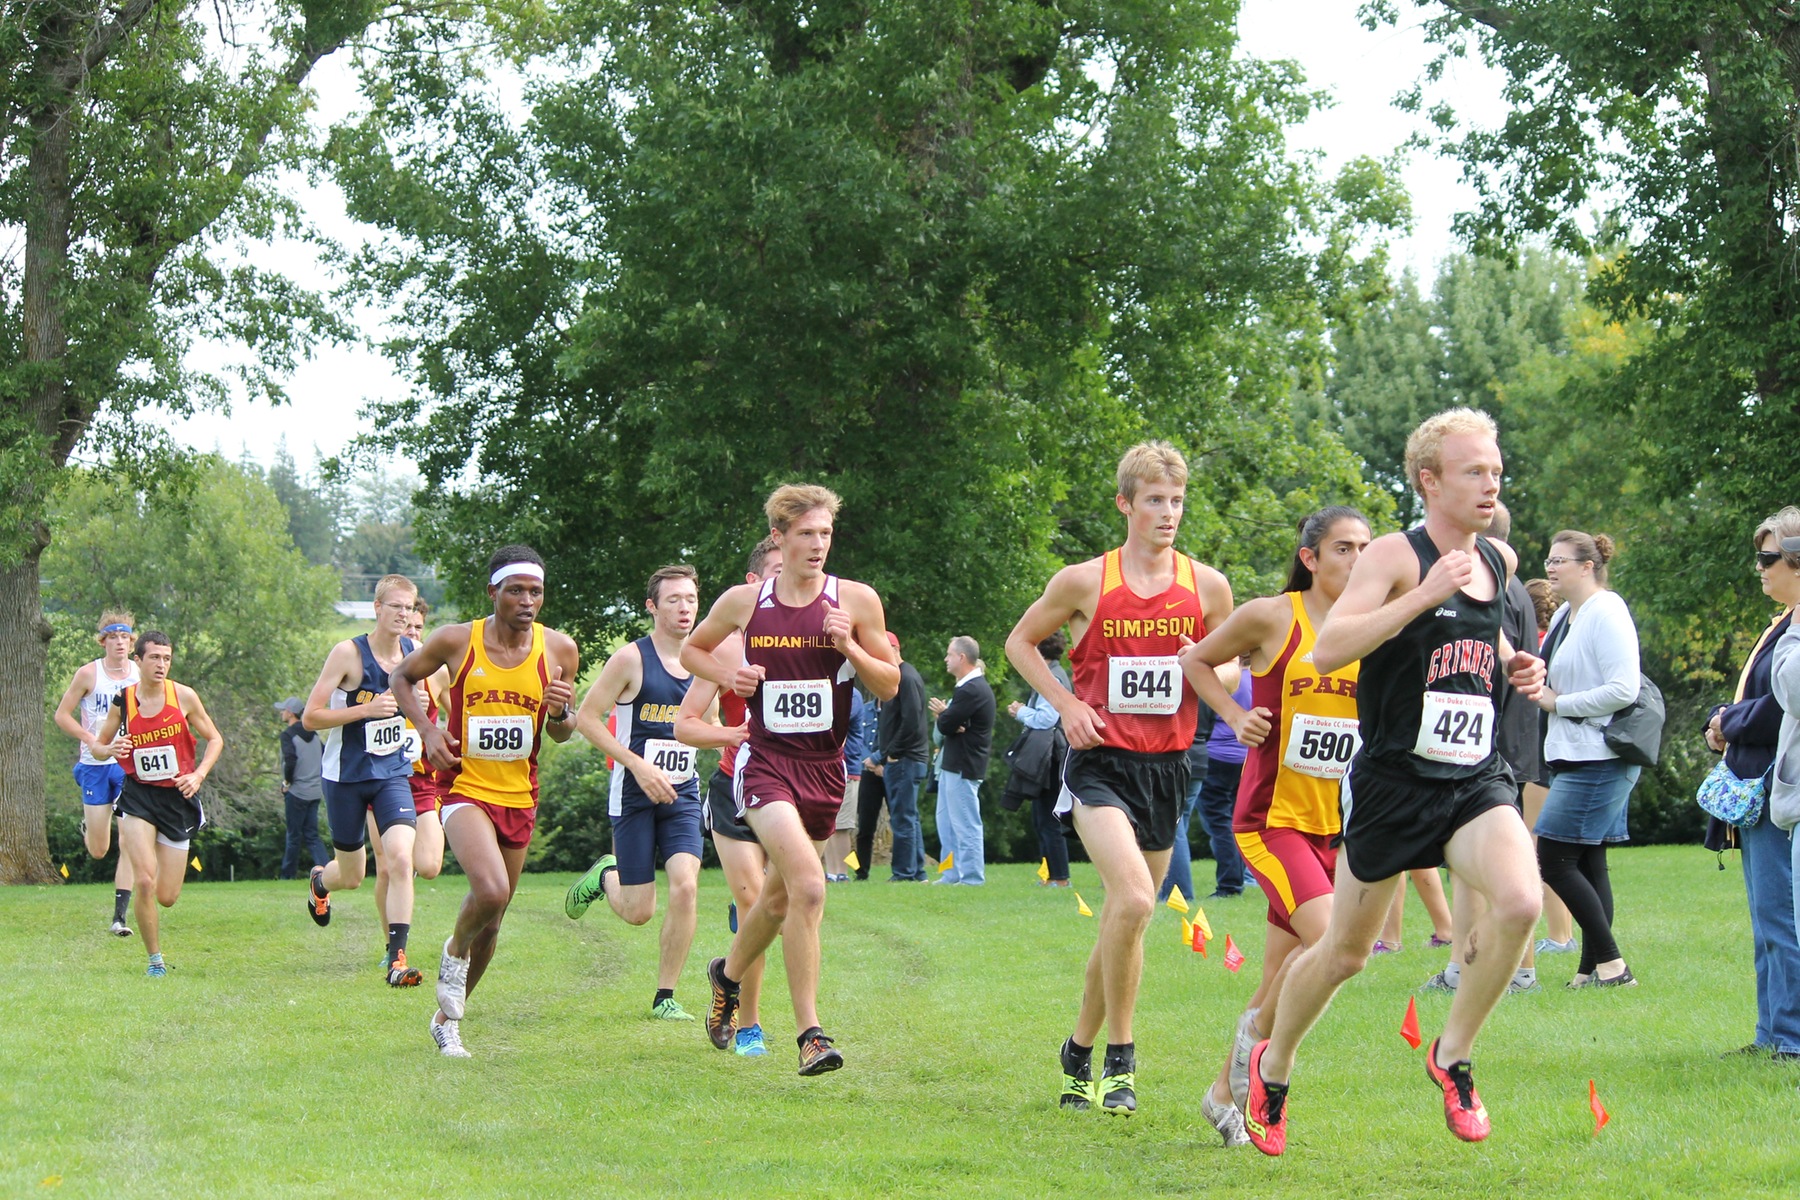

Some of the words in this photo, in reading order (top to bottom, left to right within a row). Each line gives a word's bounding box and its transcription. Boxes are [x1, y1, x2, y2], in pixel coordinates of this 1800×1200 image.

[1102, 616, 1196, 639] SIMPSON
[1121, 669, 1172, 699] 644
[1289, 676, 1358, 699] PAR
[466, 689, 539, 713] PARK
[774, 692, 822, 718] 489
[1149, 702, 1175, 710] College
[1435, 695, 1445, 703] Les
[1447, 697, 1463, 705] Duke
[1465, 698, 1471, 706] CC
[132, 722, 182, 747] SIMPSON
[1316, 719, 1332, 727] Duke
[1433, 709, 1484, 746] 424
[373, 724, 401, 746] 406
[478, 727, 523, 750] 589
[1299, 729, 1355, 763] 590
[140, 754, 169, 772] 641
[653, 750, 689, 772] 405
[1427, 747, 1457, 758] Grinnell
[1458, 750, 1482, 761] College
[1293, 762, 1323, 772] Grinnell
[1324, 766, 1345, 775] Colleg
